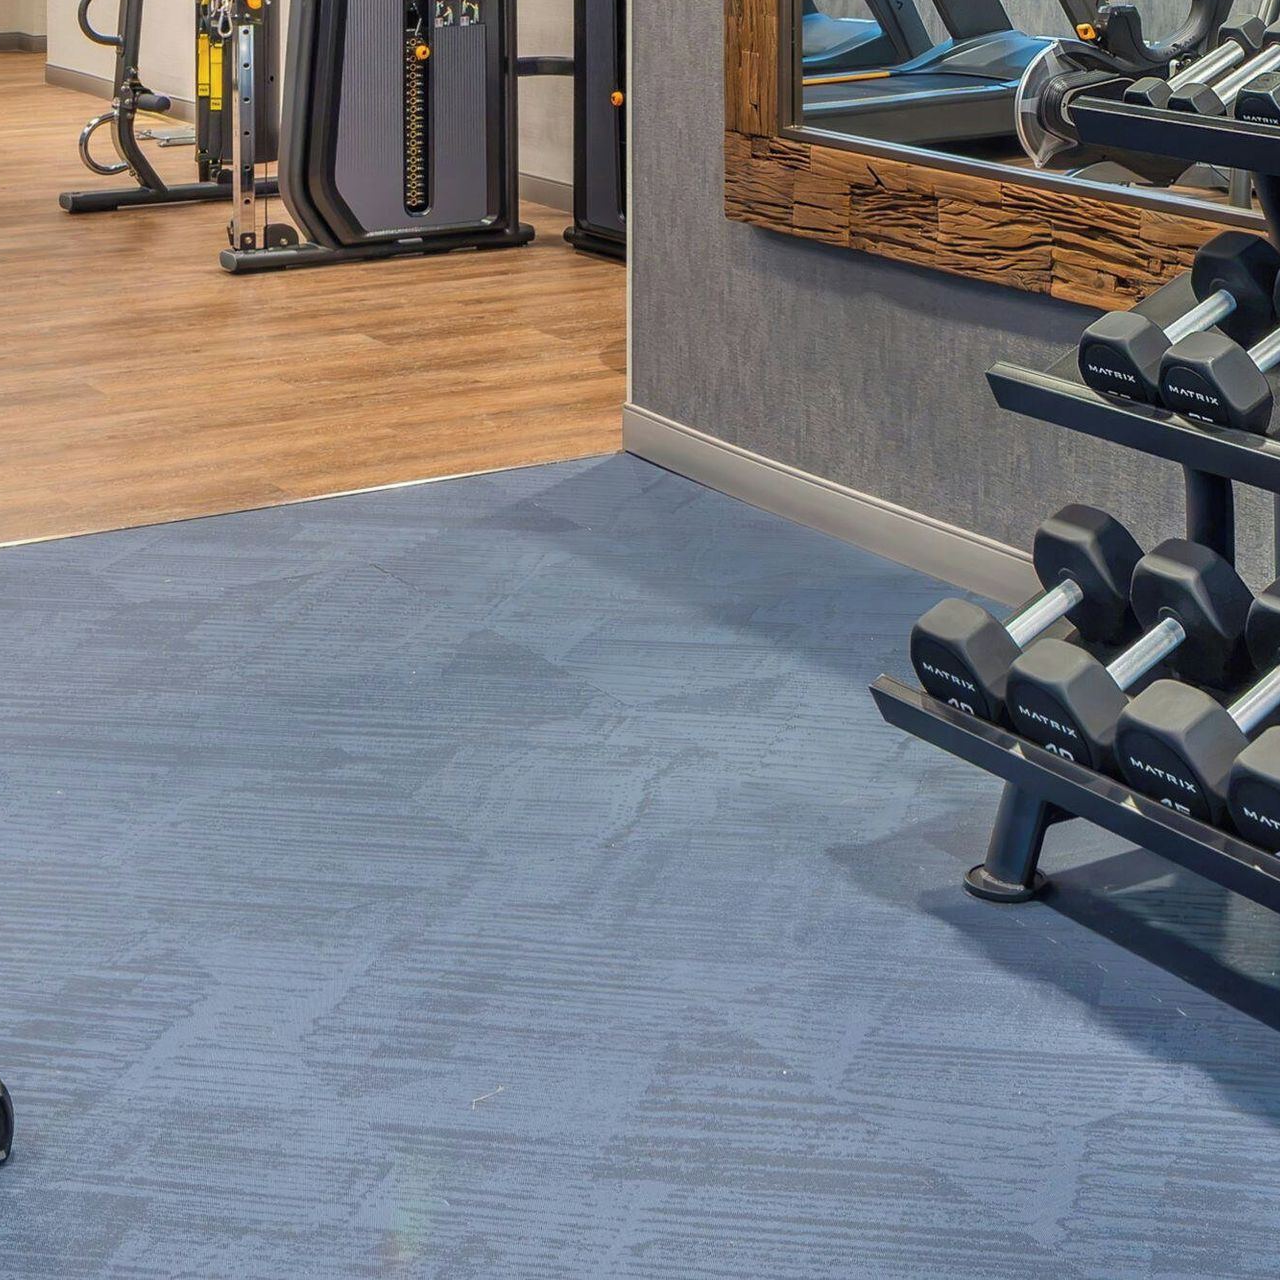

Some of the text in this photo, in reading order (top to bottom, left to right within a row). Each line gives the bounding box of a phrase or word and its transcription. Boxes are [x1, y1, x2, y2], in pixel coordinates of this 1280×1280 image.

[1243, 115, 1279, 124] MATRIX
[1088, 364, 1136, 383] MATRIX
[1168, 384, 1219, 406] MATRIX
[922, 662, 976, 692] MATRIX
[1019, 705, 1077, 738] MATRIX
[1130, 756, 1197, 793] MATRIX
